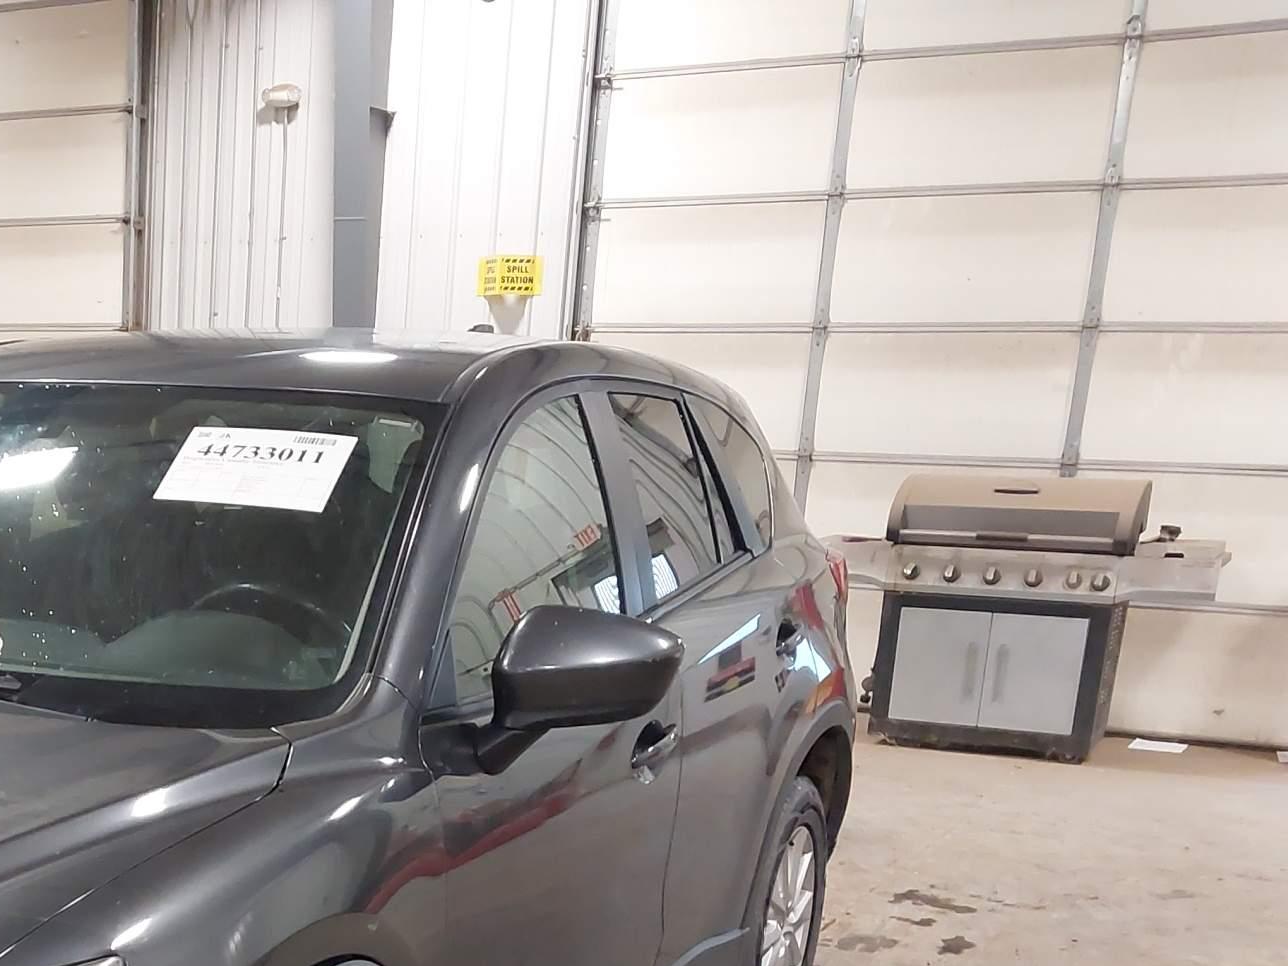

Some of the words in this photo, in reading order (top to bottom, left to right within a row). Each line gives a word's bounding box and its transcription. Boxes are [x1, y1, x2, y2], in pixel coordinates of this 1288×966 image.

[506, 265, 529, 274] SPILL
[500, 275, 534, 285] STATION
[197, 444, 325, 464] 44733011
